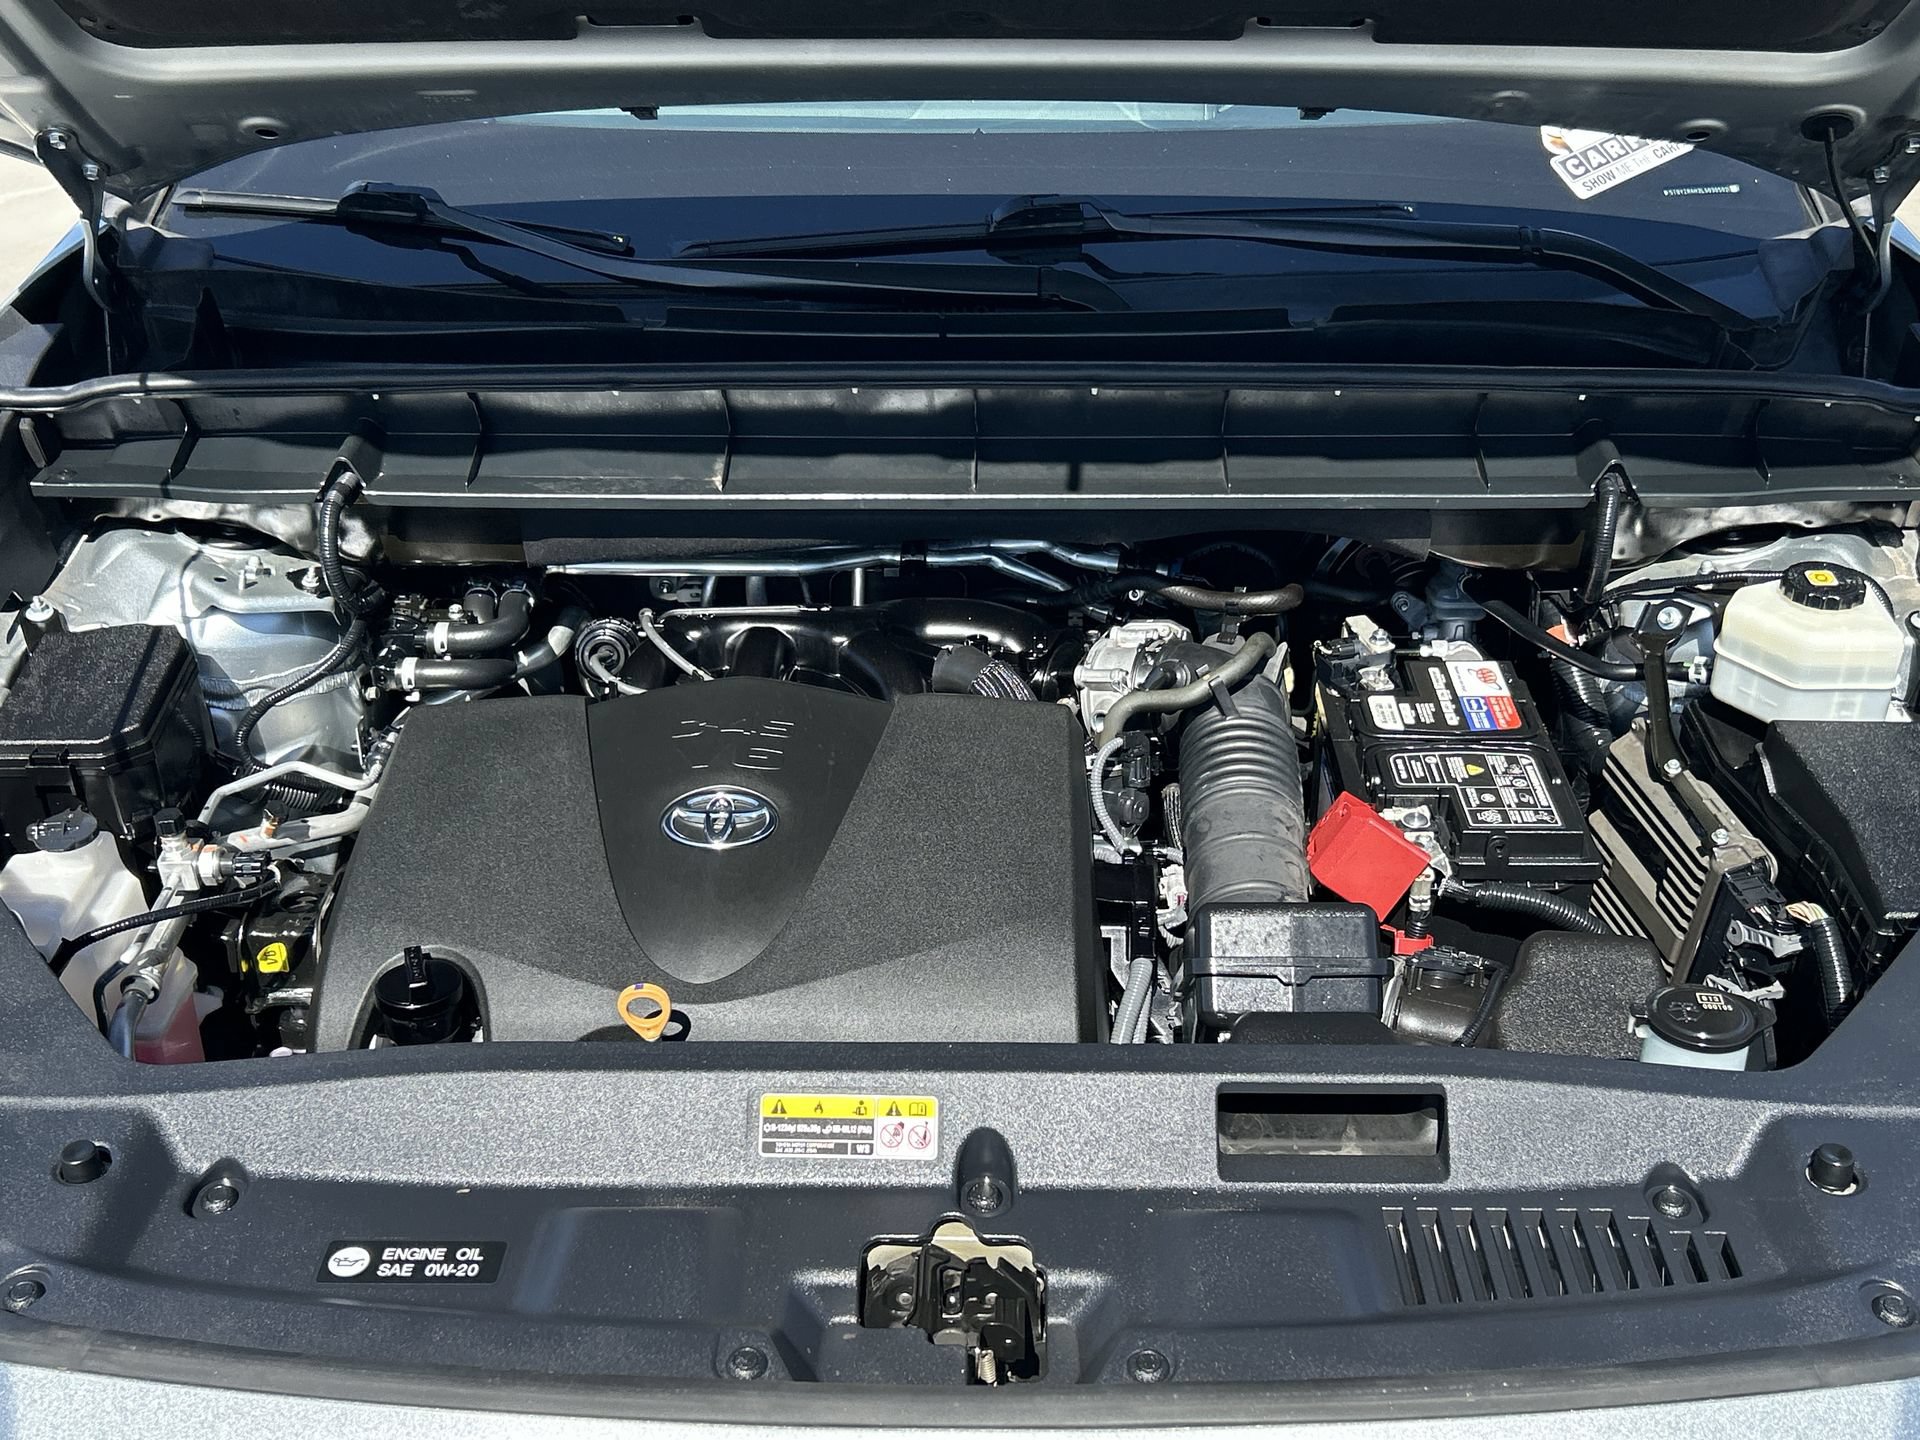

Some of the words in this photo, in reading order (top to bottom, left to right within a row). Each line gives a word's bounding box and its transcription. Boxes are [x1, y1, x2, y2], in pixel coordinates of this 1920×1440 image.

[1582, 170, 1616, 192] SHOW
[1616, 162, 1632, 176] ME
[381, 1247, 448, 1261] ENGINE
[455, 1247, 485, 1261] OIL
[376, 1263, 415, 1278] SAE
[423, 1263, 480, 1278] 0W-20
